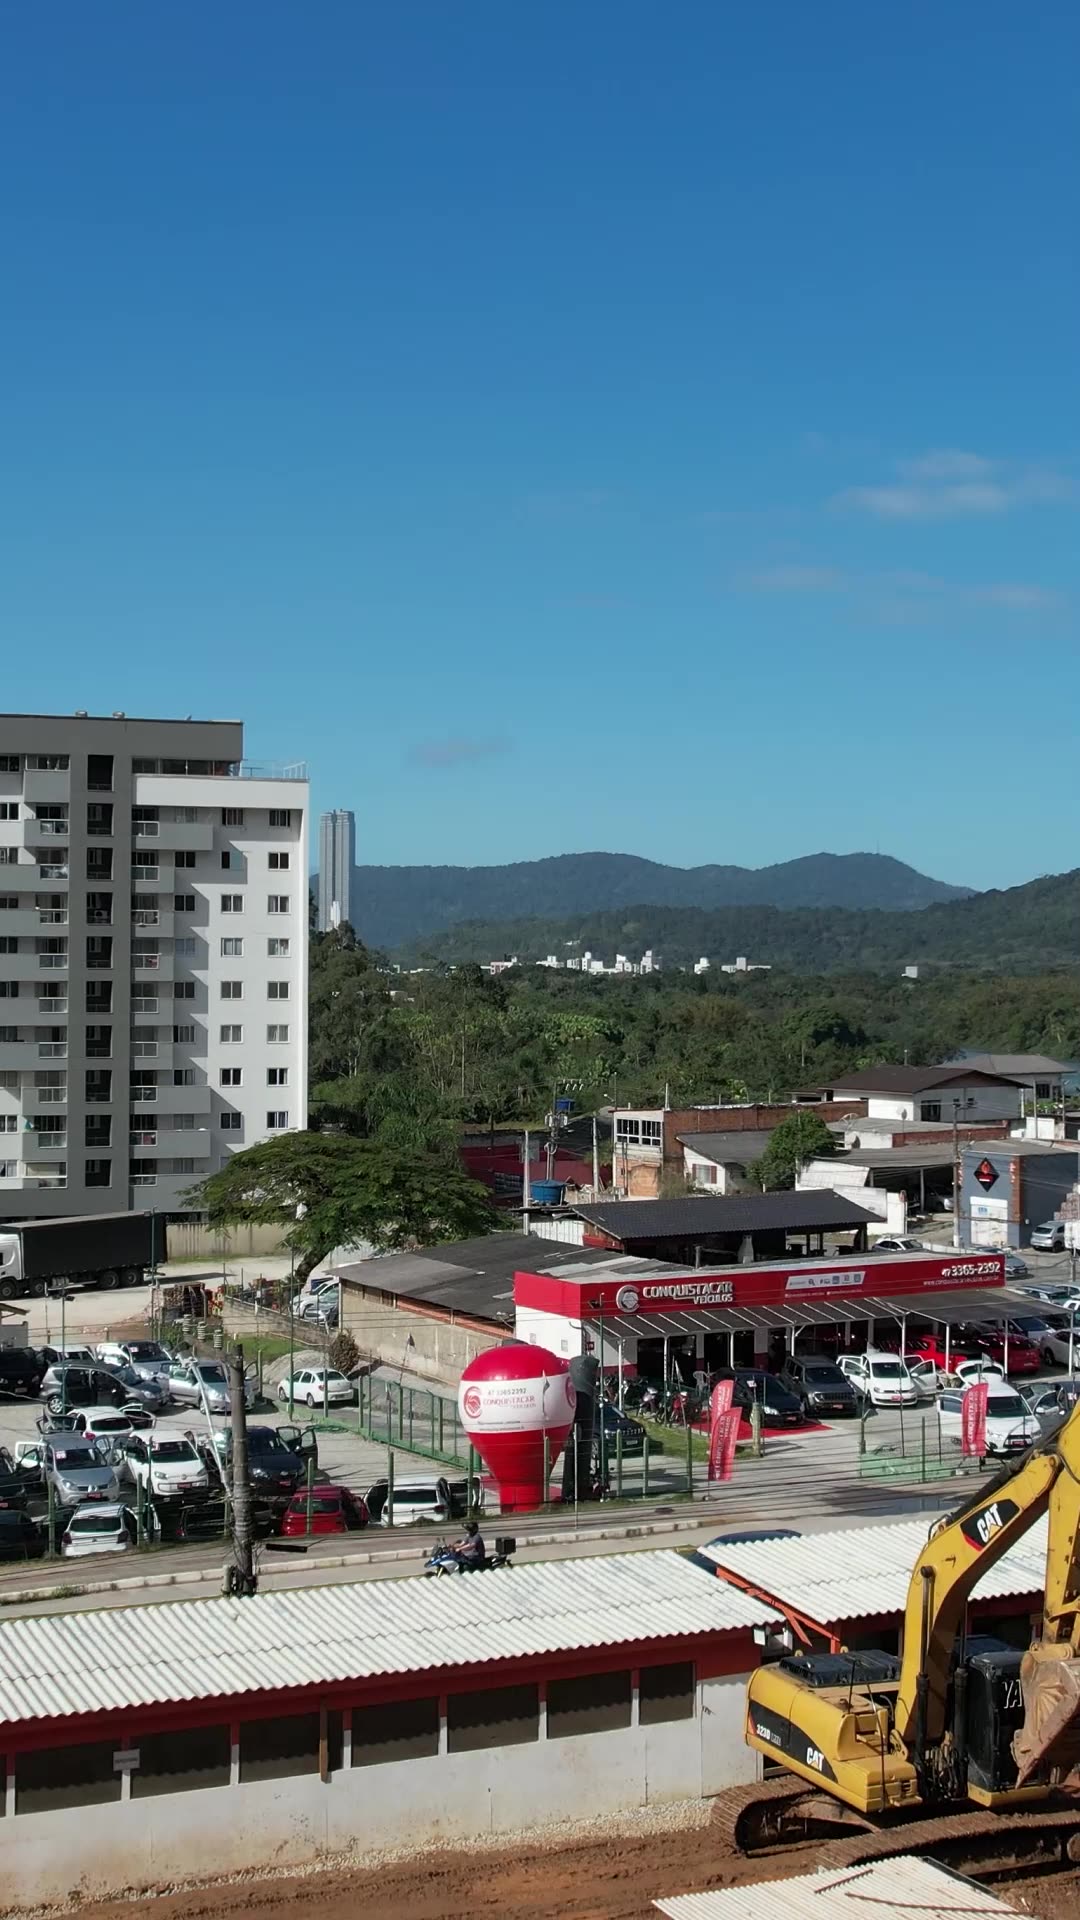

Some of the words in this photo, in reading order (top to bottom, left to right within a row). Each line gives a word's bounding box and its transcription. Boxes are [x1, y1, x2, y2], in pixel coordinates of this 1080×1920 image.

[951, 1262, 1000, 1276] 3365-2392
[642, 1281, 733, 1299] CONQUISTACAR
[976, 1503, 1003, 1543] CAT
[806, 1747, 825, 1772] CAT
